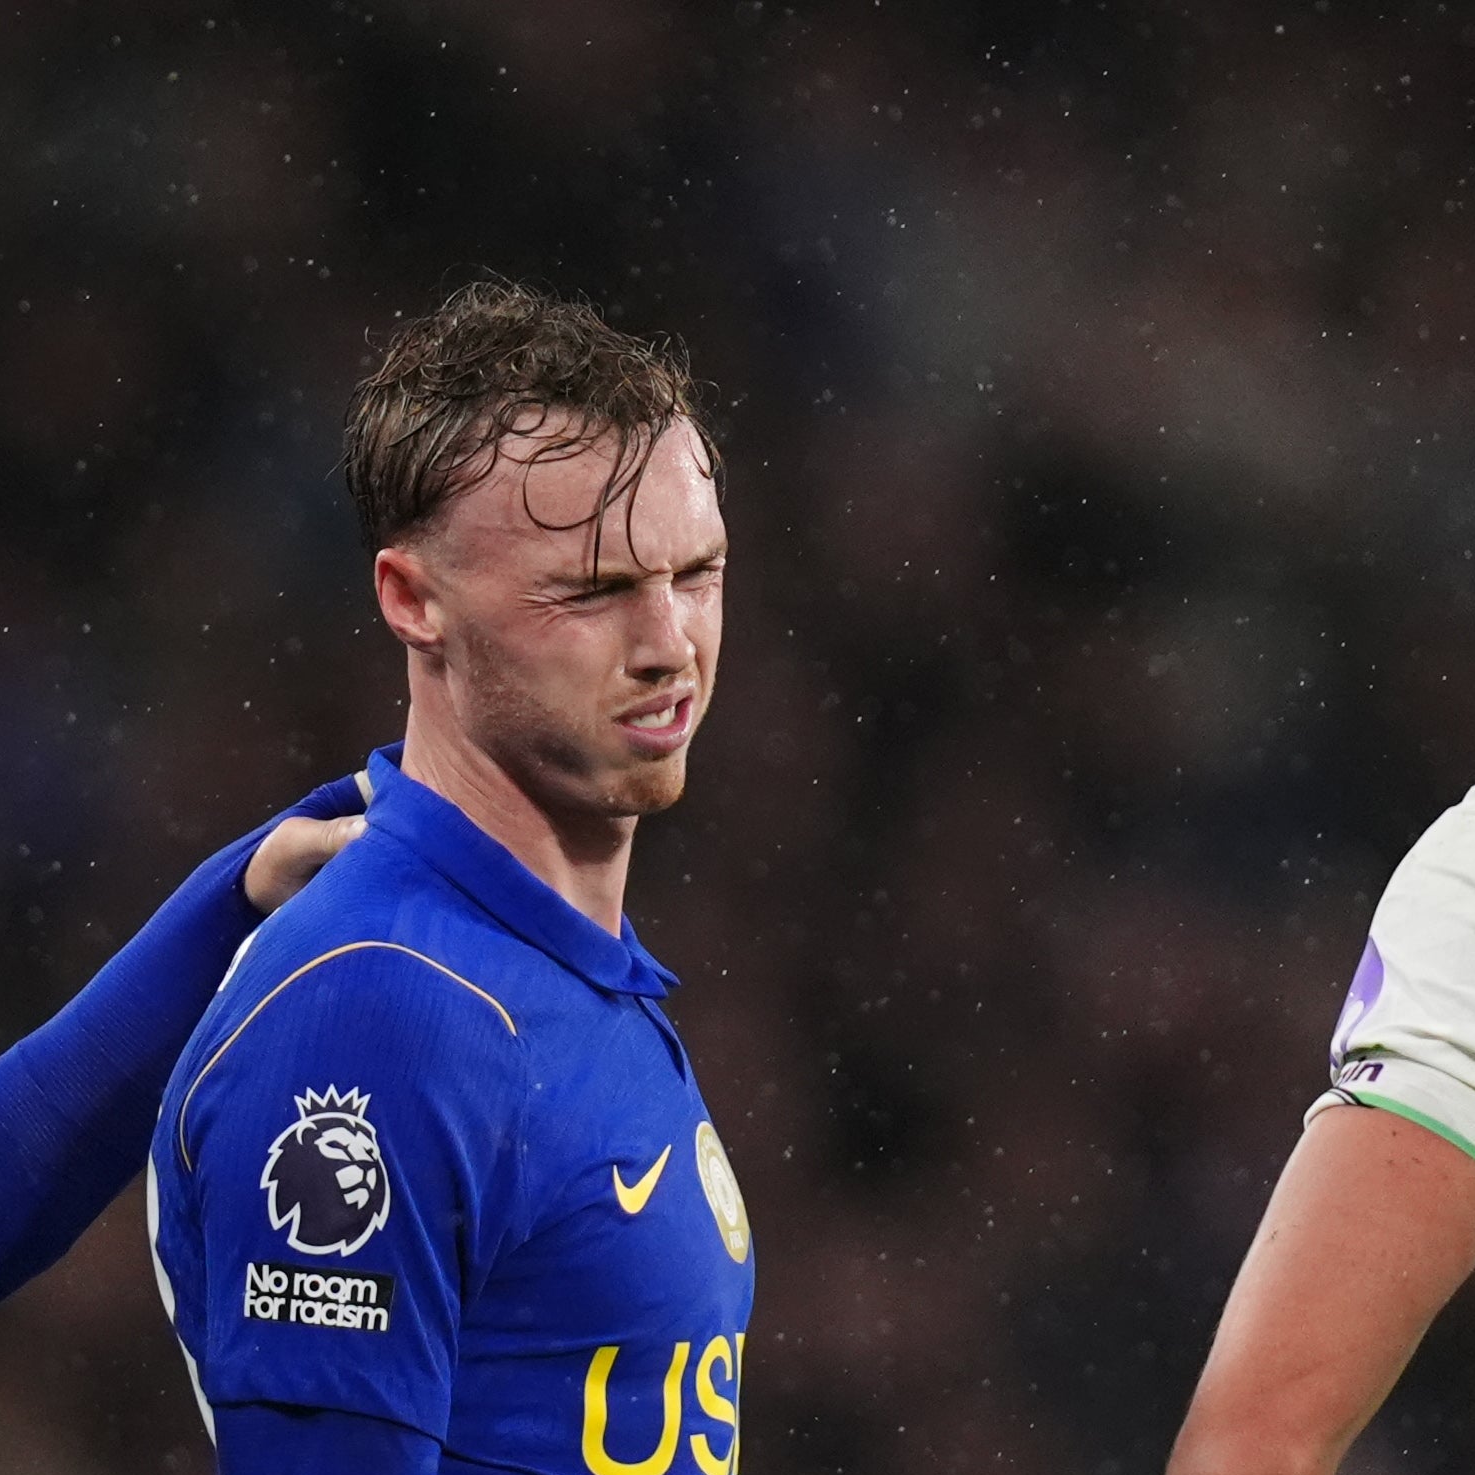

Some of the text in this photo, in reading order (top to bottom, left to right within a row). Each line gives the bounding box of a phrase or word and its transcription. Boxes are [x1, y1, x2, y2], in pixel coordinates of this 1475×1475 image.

[245, 1262, 378, 1303] No room
[243, 1289, 389, 1331] for racism
